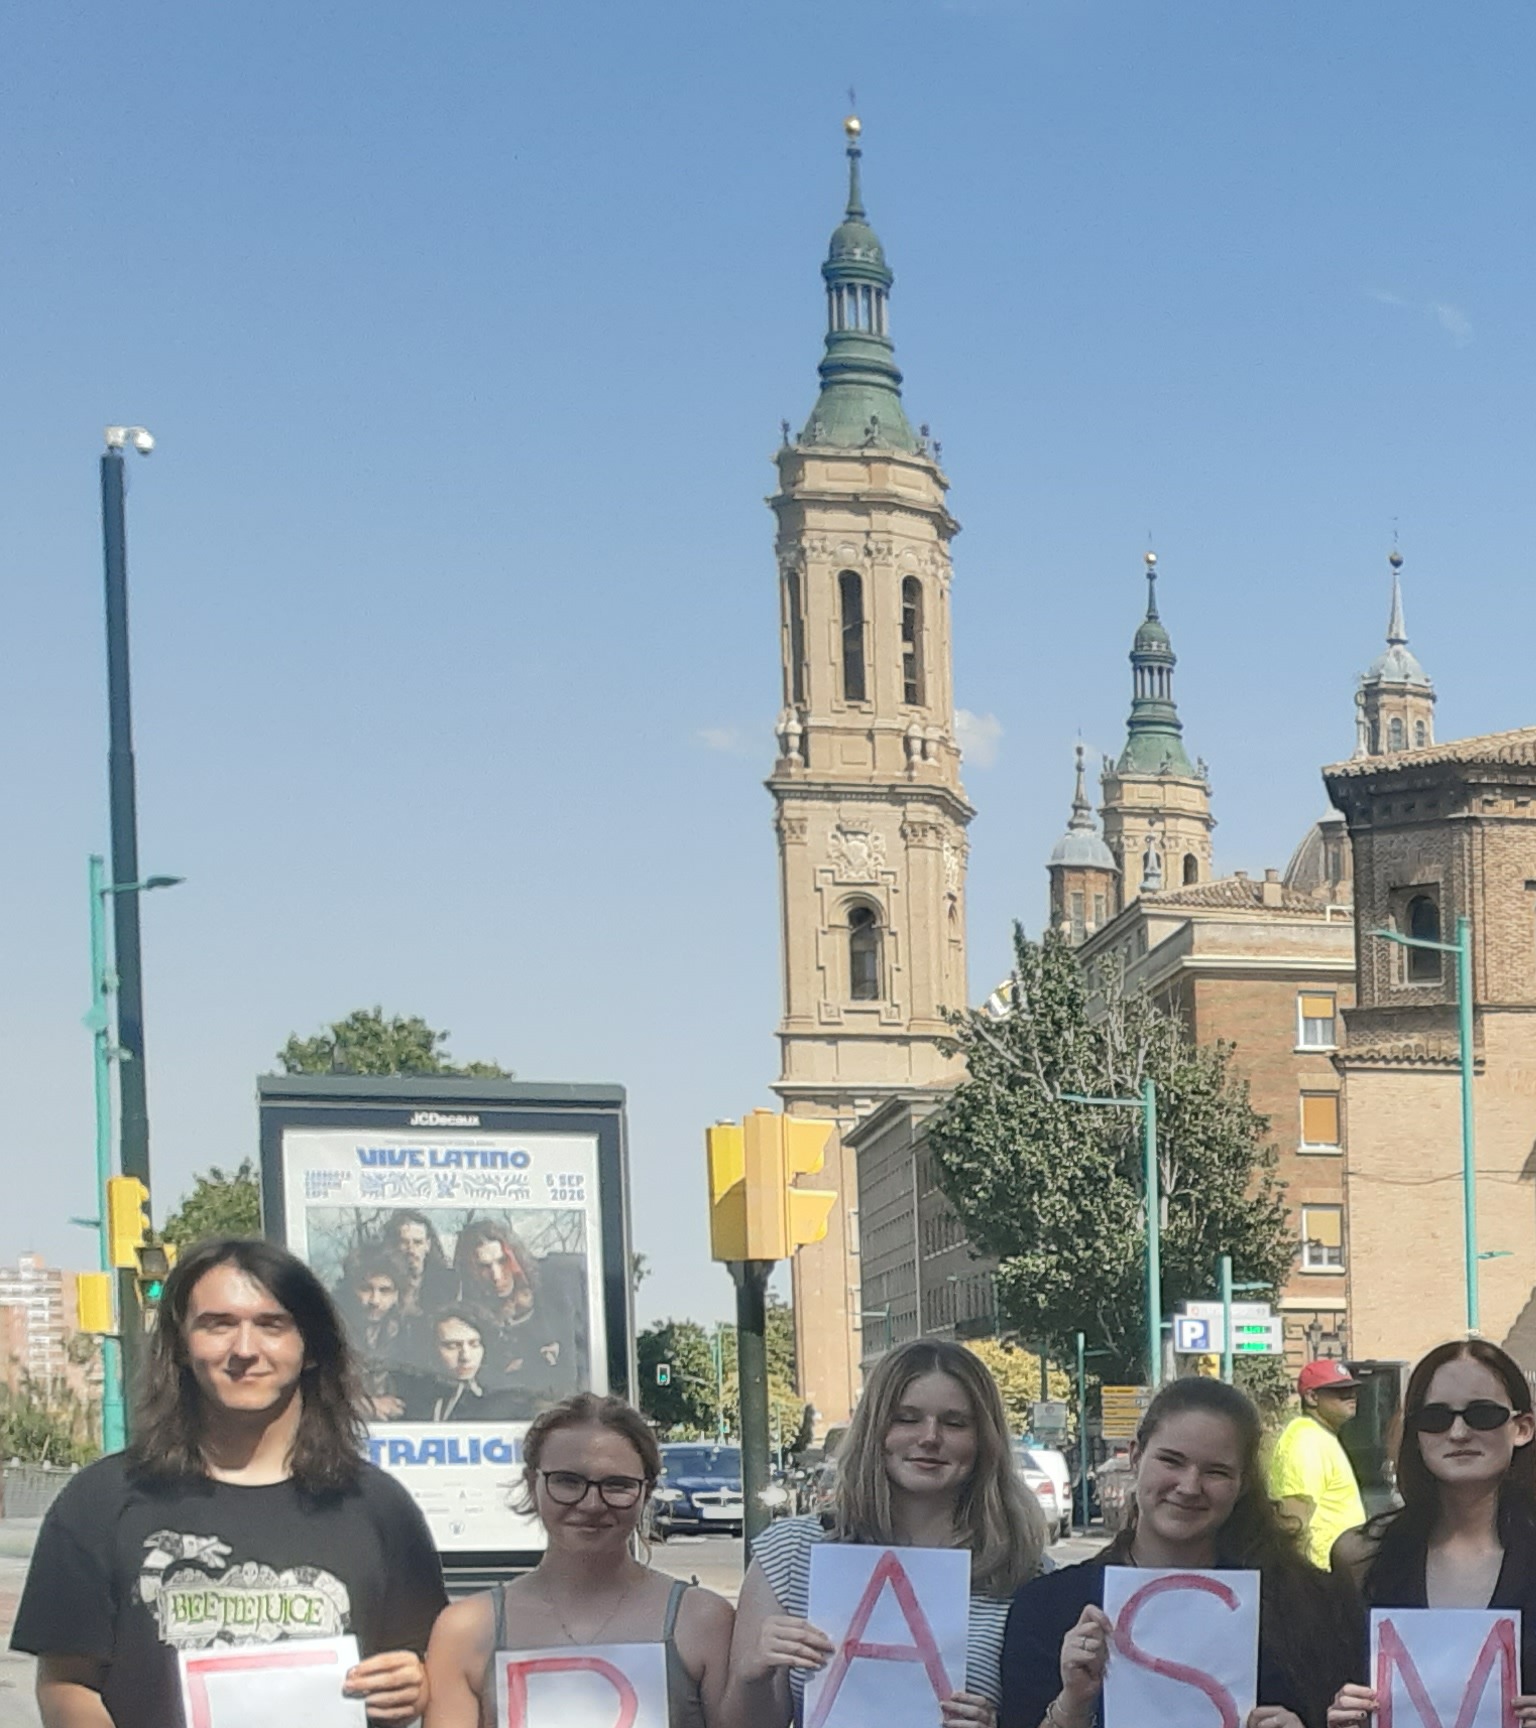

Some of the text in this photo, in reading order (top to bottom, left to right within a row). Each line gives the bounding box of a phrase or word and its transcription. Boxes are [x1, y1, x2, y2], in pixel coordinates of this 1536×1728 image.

[410, 1111, 480, 1126] JCDecaux
[356, 1147, 531, 1168] VIVE LATINO
[1182, 1321, 1204, 1348] P
[367, 1437, 523, 1466] TRALIG
[172, 1591, 325, 1632] BEETLEJUICE
